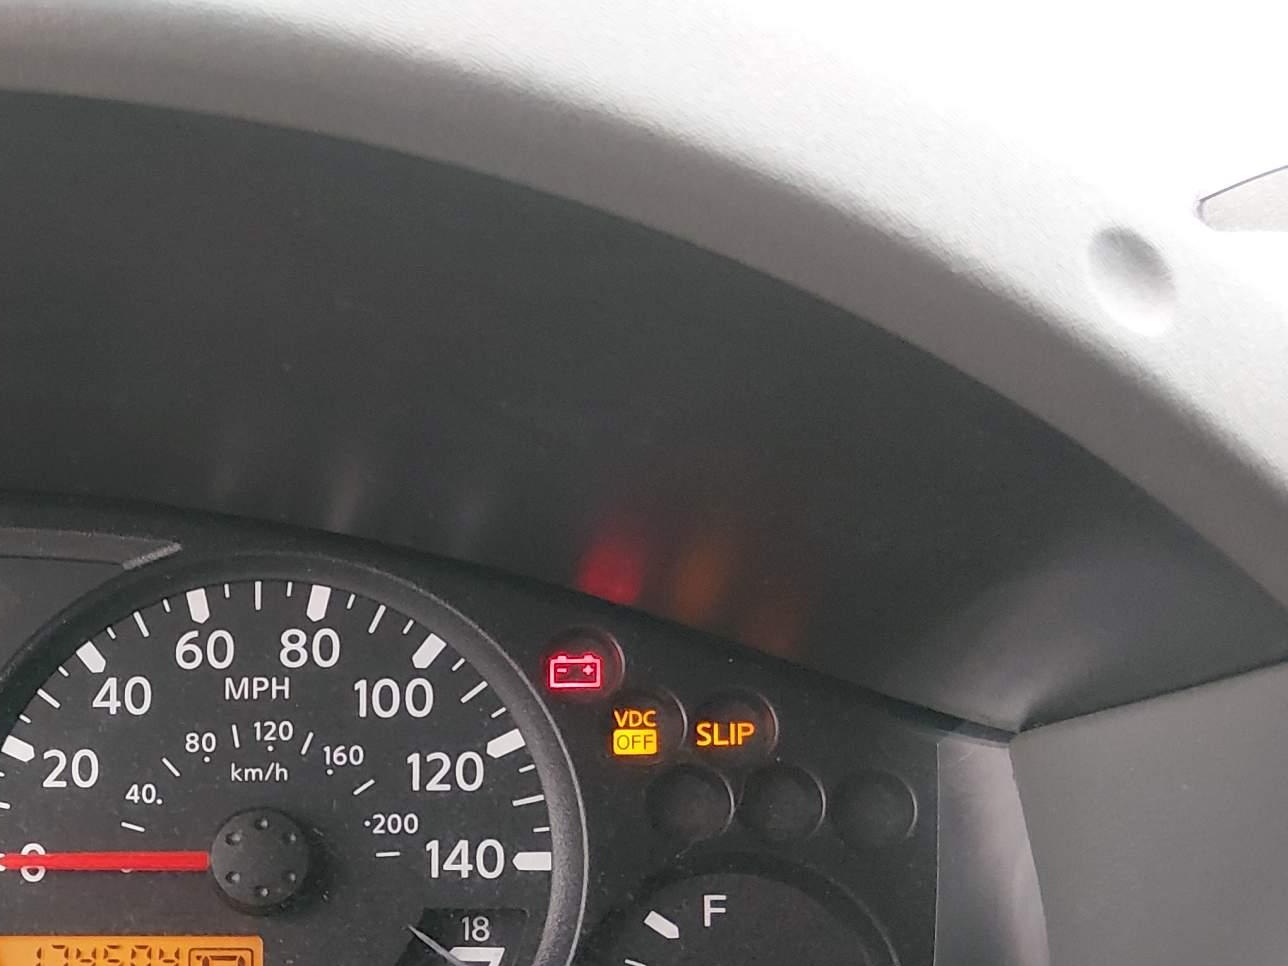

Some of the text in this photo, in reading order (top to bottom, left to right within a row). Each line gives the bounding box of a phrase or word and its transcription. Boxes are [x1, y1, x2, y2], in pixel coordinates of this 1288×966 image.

[175, 629, 235, 670] 60
[279, 628, 340, 668] 80
[91, 677, 152, 715] 40
[225, 677, 290, 700] MPH
[354, 677, 434, 718] 100
[253, 720, 294, 741] 120
[614, 709, 657, 728] VDC
[185, 732, 216, 753] 80
[616, 734, 653, 750] OFF
[696, 722, 755, 747] SLIP
[42, 748, 99, 788] 20
[323, 745, 364, 766] 160
[231, 762, 288, 784] km/h
[407, 751, 484, 792] 120
[125, 783, 156, 804] 40
[372, 813, 419, 834] 200
[426, 839, 505, 879] 140
[703, 894, 727, 927] F
[461, 916, 490, 942] 18
